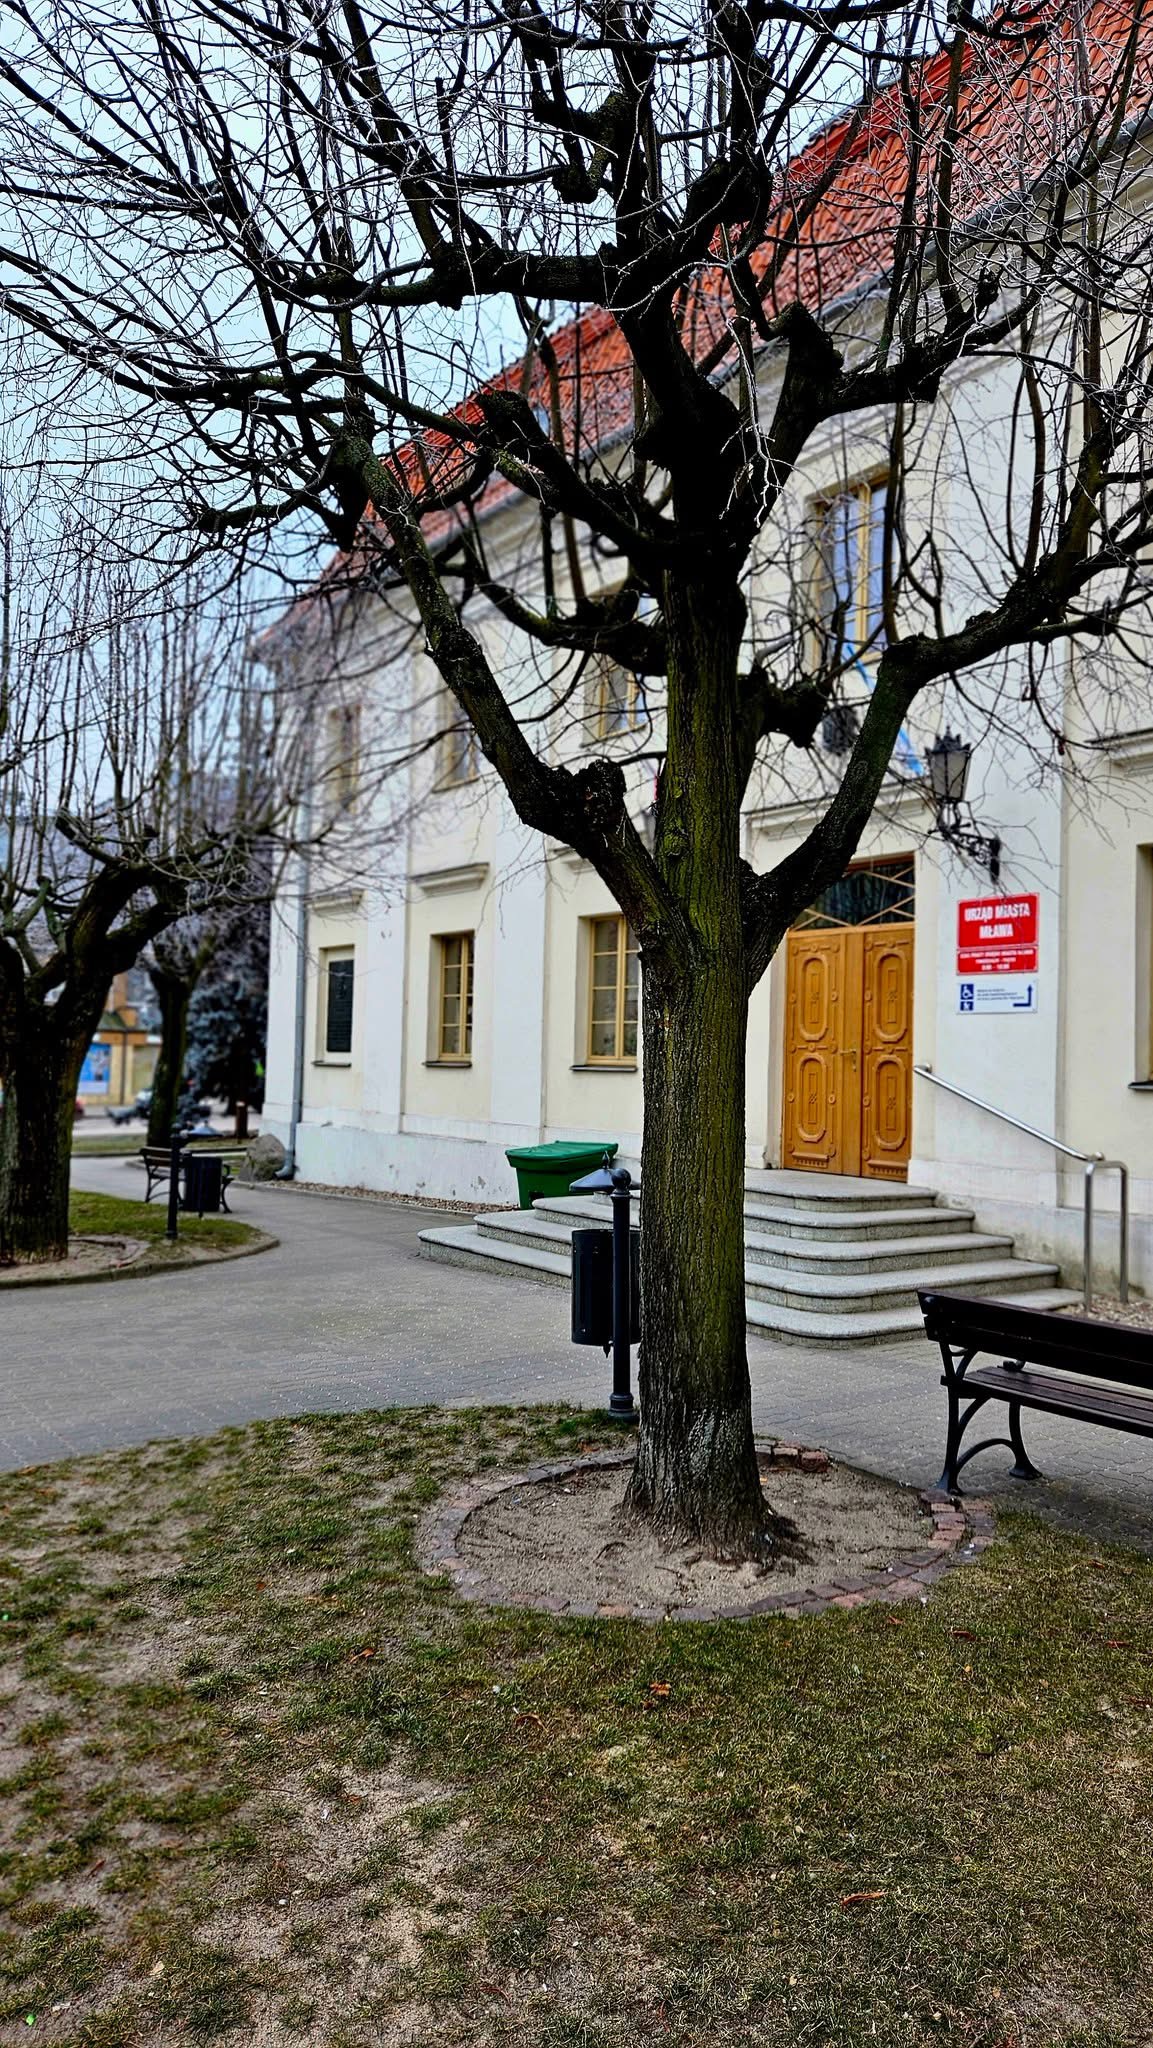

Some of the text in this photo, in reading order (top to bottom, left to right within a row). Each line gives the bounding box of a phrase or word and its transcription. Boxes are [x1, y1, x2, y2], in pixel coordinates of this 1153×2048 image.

[964, 903, 1031, 922] URZĄD MIASTA
[979, 923, 1014, 939] MŁAWA
